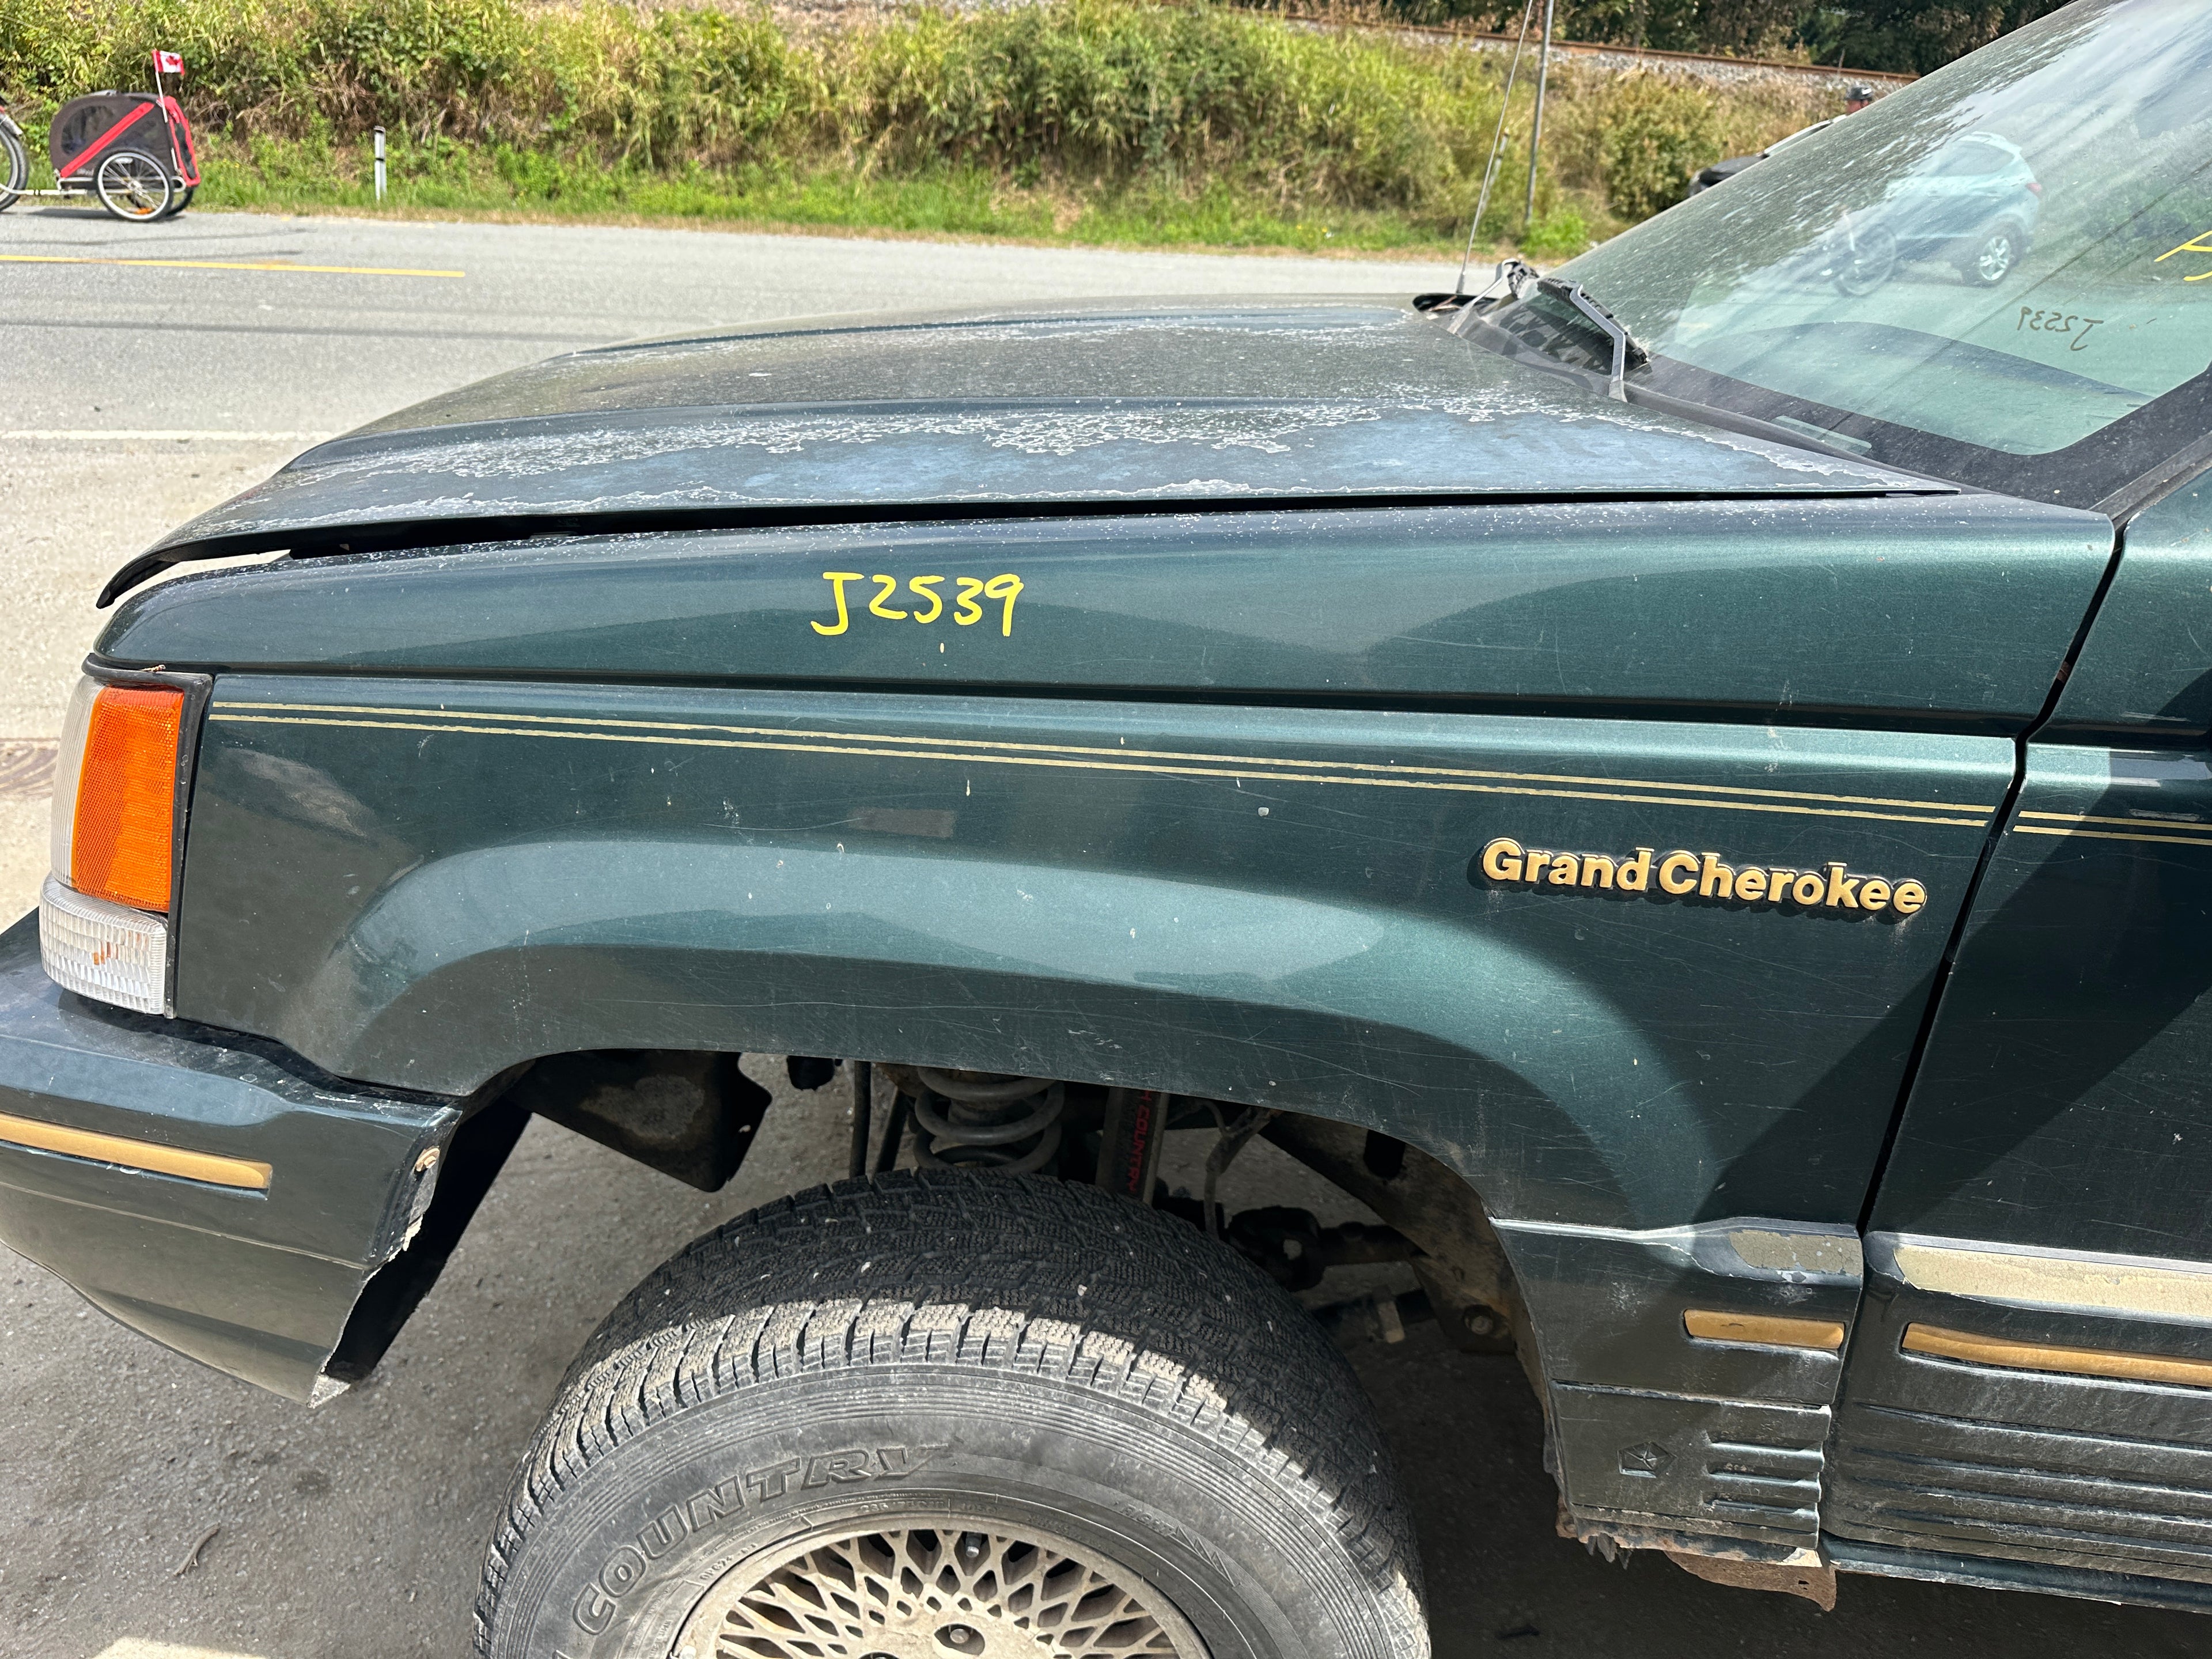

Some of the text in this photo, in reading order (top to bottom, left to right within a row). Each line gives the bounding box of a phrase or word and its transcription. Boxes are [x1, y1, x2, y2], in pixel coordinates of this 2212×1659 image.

[810, 571, 1024, 637] J2539
[1481, 837, 1928, 915] Grand Cherokee
[1128, 1104, 1150, 1192] COUNTRY
[573, 1442, 948, 1635] COUNTRY
